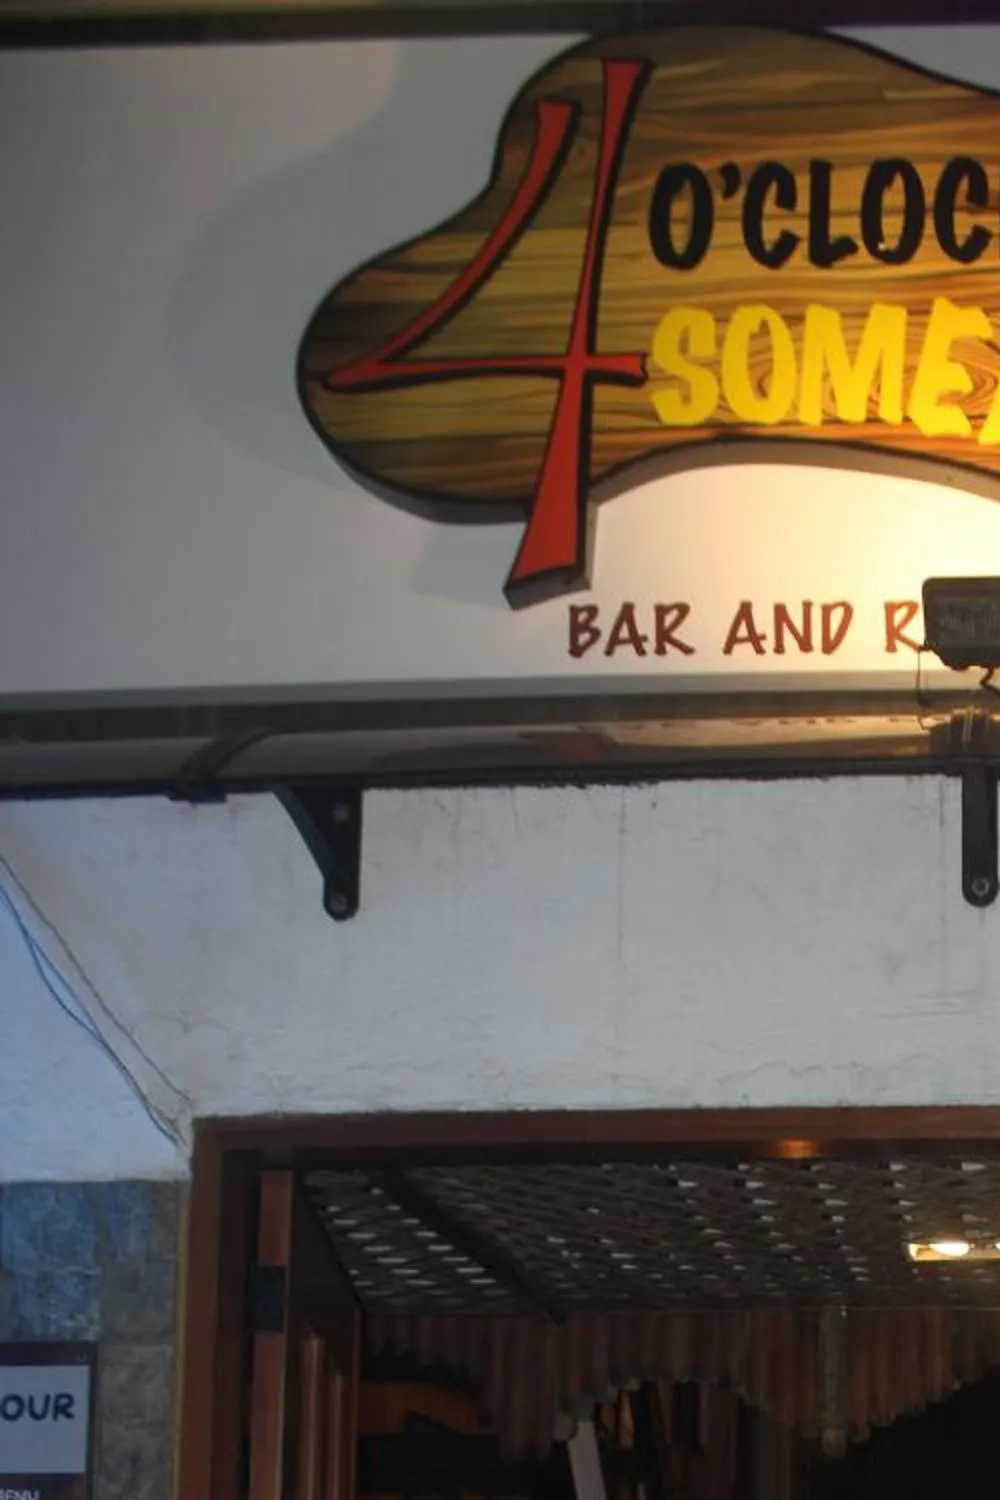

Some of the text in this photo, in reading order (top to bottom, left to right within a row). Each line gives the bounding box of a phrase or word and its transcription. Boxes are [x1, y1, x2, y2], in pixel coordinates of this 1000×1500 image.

[322, 58, 653, 605] 4
[567, 602, 694, 658] BAR
[722, 602, 854, 656] AND
